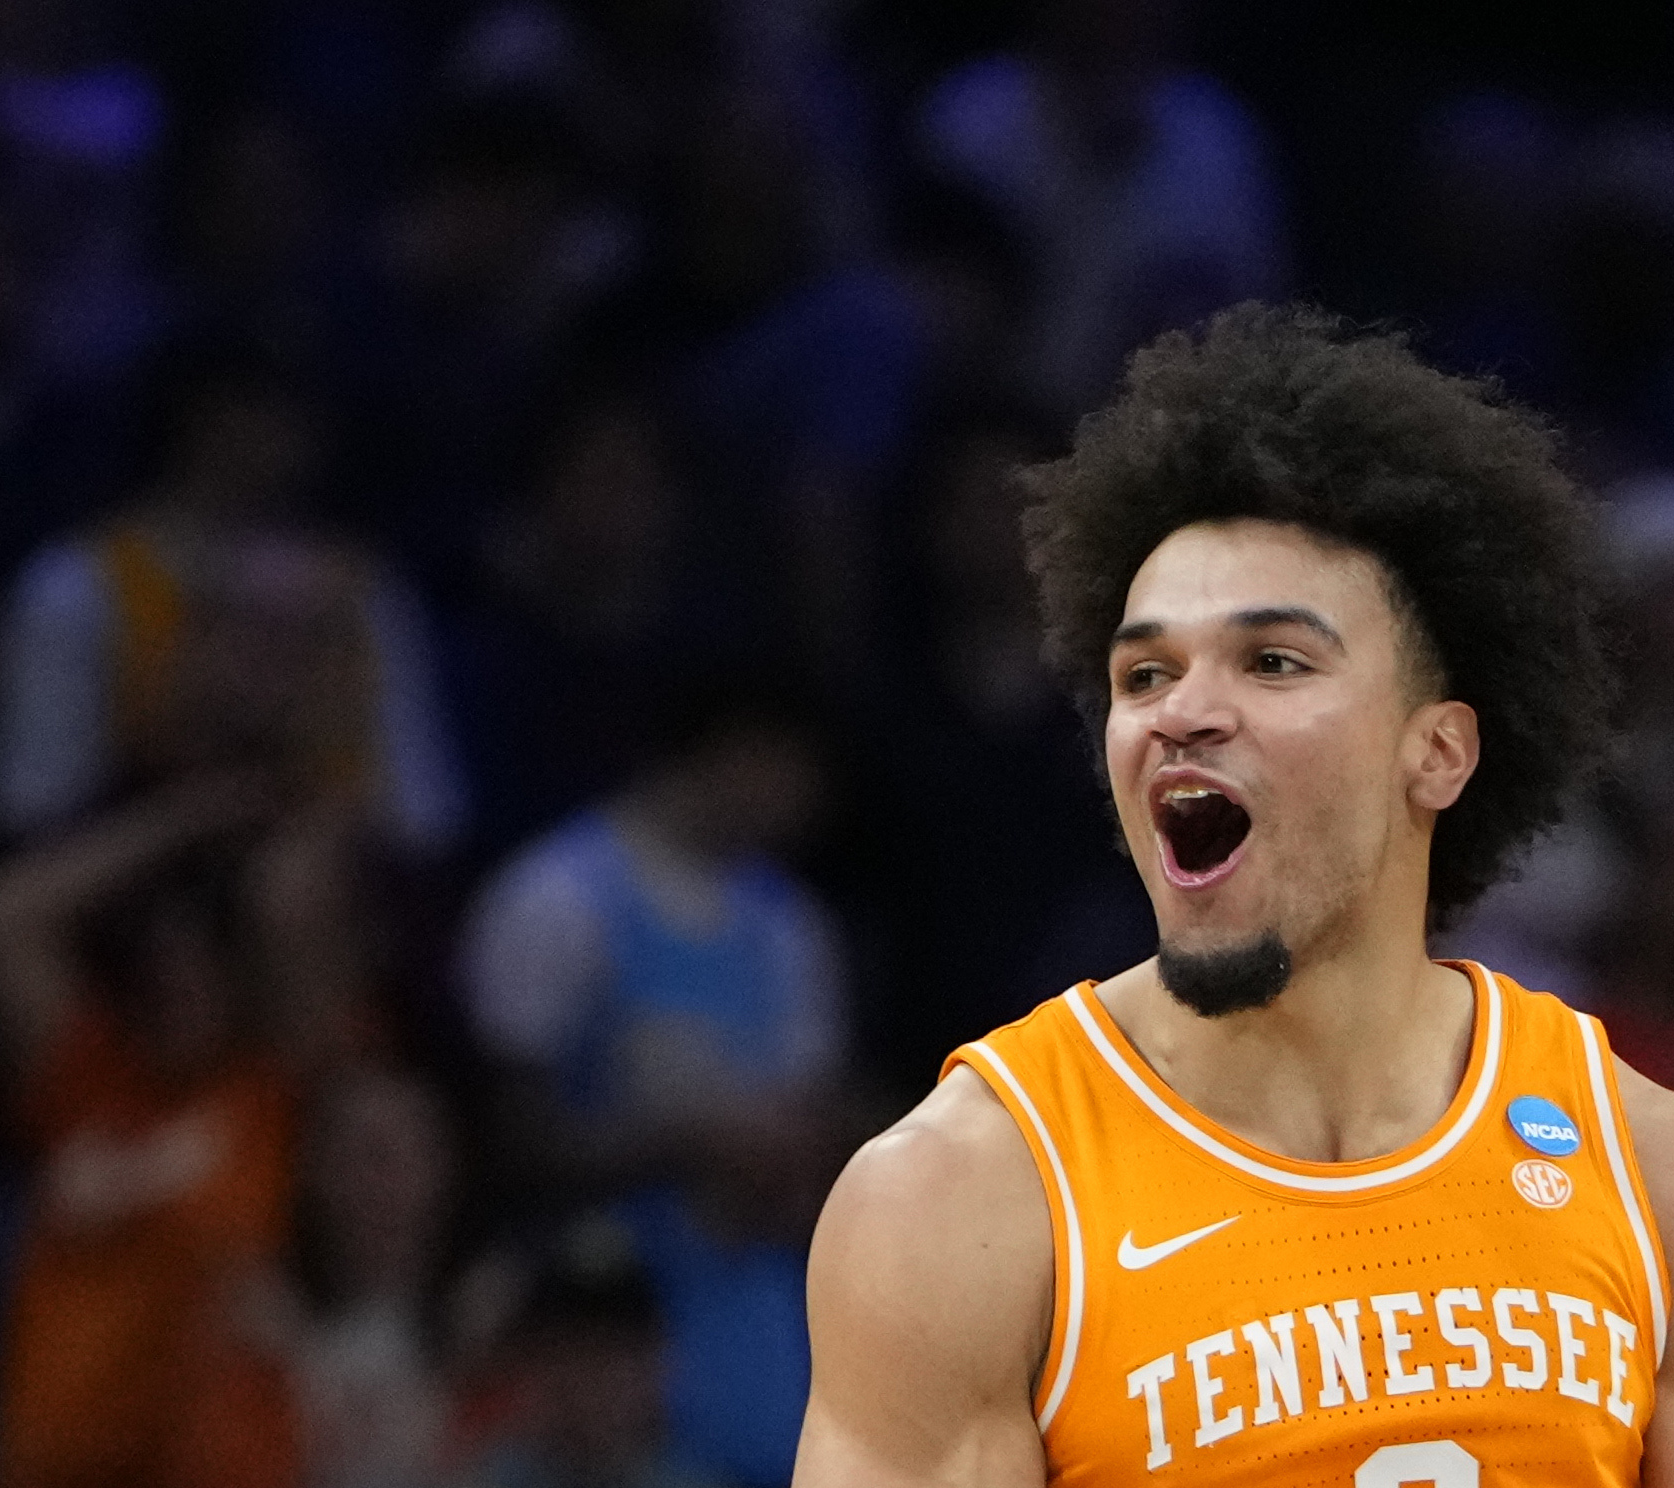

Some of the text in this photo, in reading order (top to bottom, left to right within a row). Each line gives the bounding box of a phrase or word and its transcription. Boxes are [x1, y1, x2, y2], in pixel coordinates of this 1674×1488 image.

[1520, 1121, 1578, 1142] NCAA
[1517, 1164, 1566, 1204] SEC
[1126, 1286, 1638, 1471] TENNESSEE
